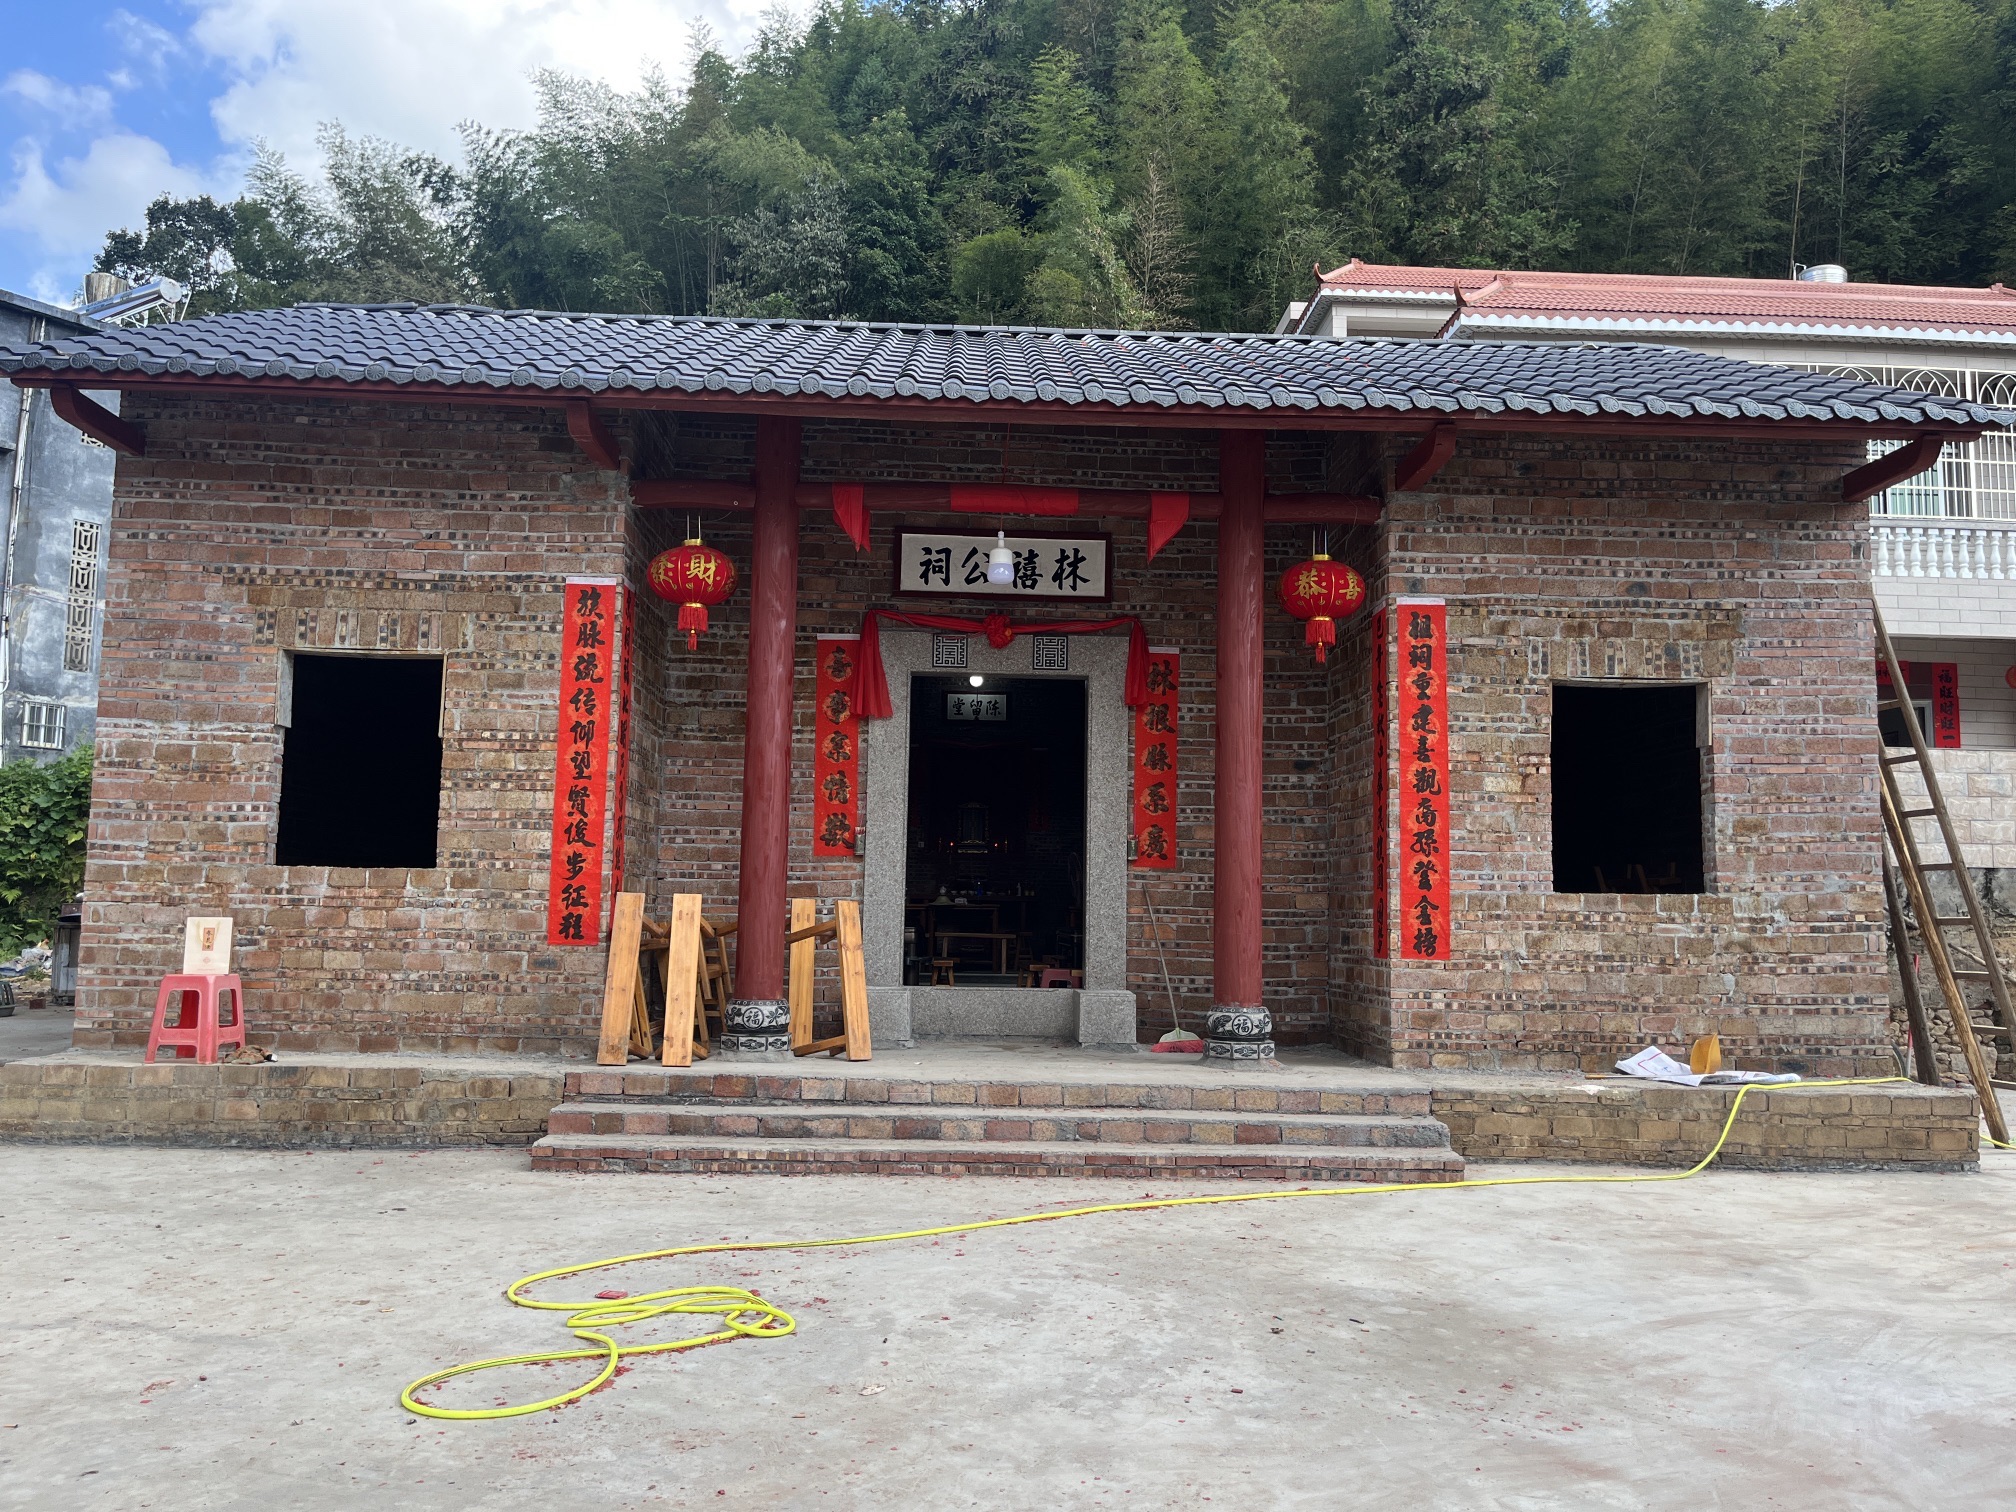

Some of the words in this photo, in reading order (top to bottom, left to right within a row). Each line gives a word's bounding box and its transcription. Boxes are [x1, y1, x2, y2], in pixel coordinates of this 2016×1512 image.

[1938, 669, 1956, 749] 福旺财旺一
